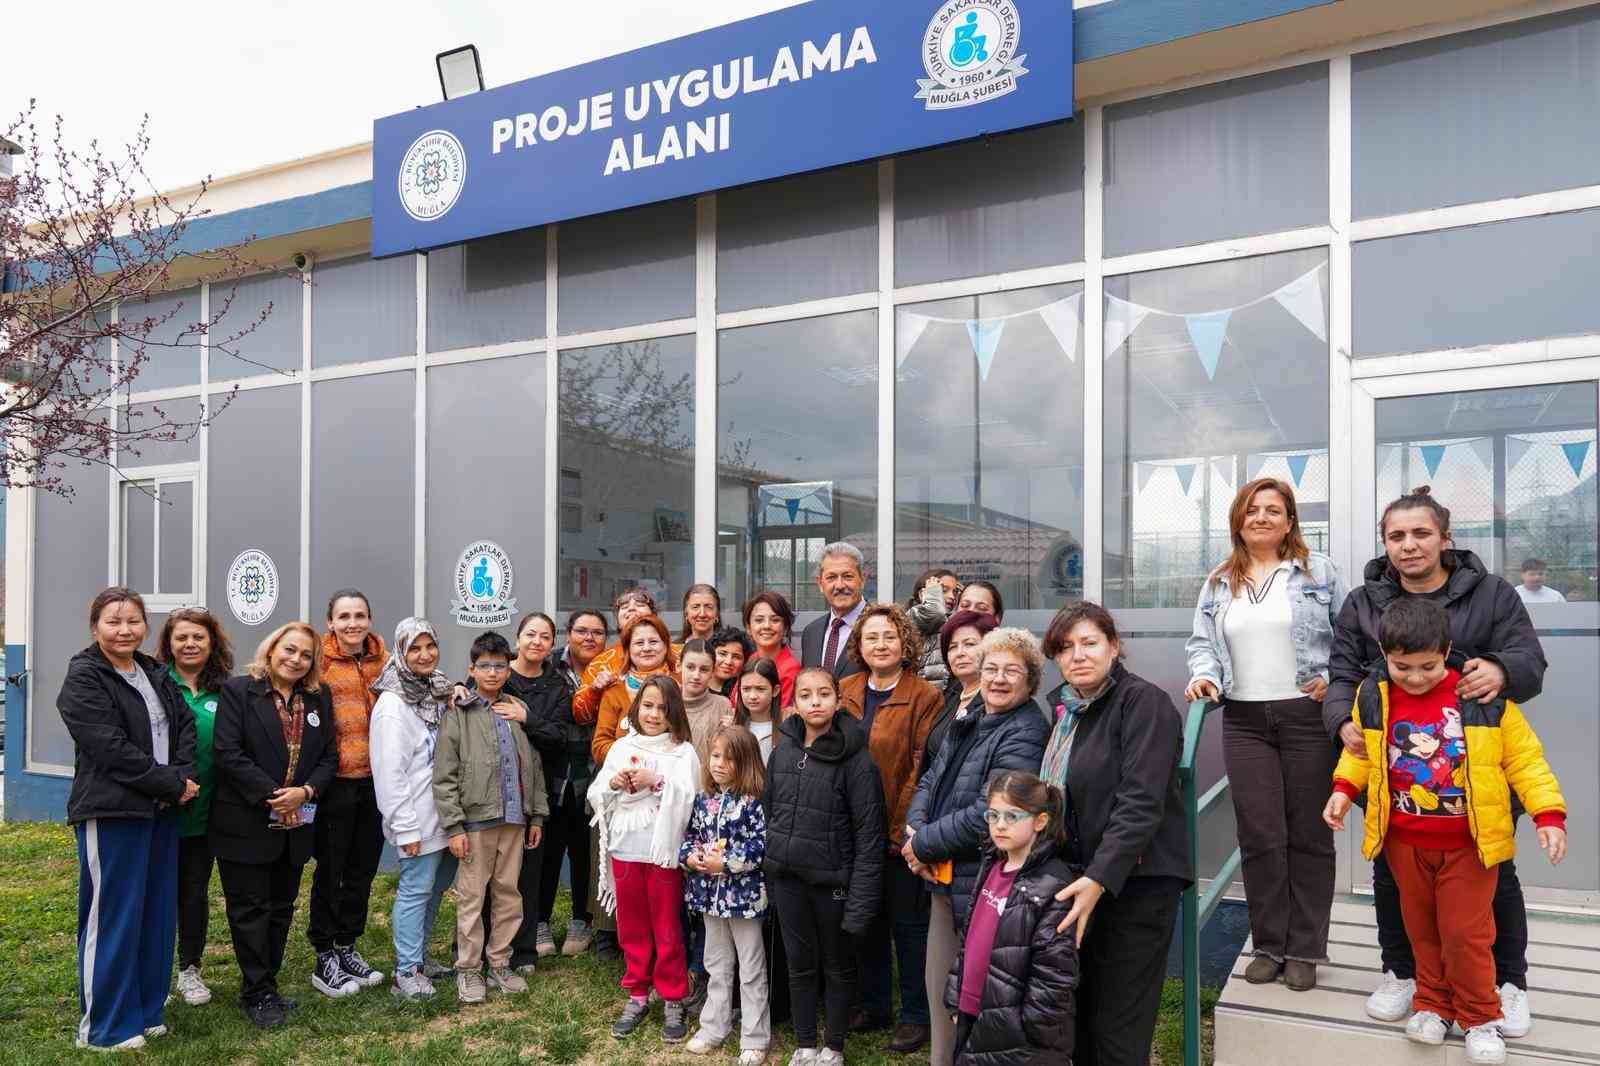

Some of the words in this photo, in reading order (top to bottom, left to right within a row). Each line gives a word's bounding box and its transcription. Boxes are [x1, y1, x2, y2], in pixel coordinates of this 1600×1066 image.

[491, 91, 613, 154] PROJE
[624, 25, 878, 121] UYGULAMA
[960, 72, 984, 85] 1960
[972, 76, 1012, 100] ŞUBESİ
[603, 113, 731, 176] ALANI
[465, 544, 502, 562] SAKATLAR
